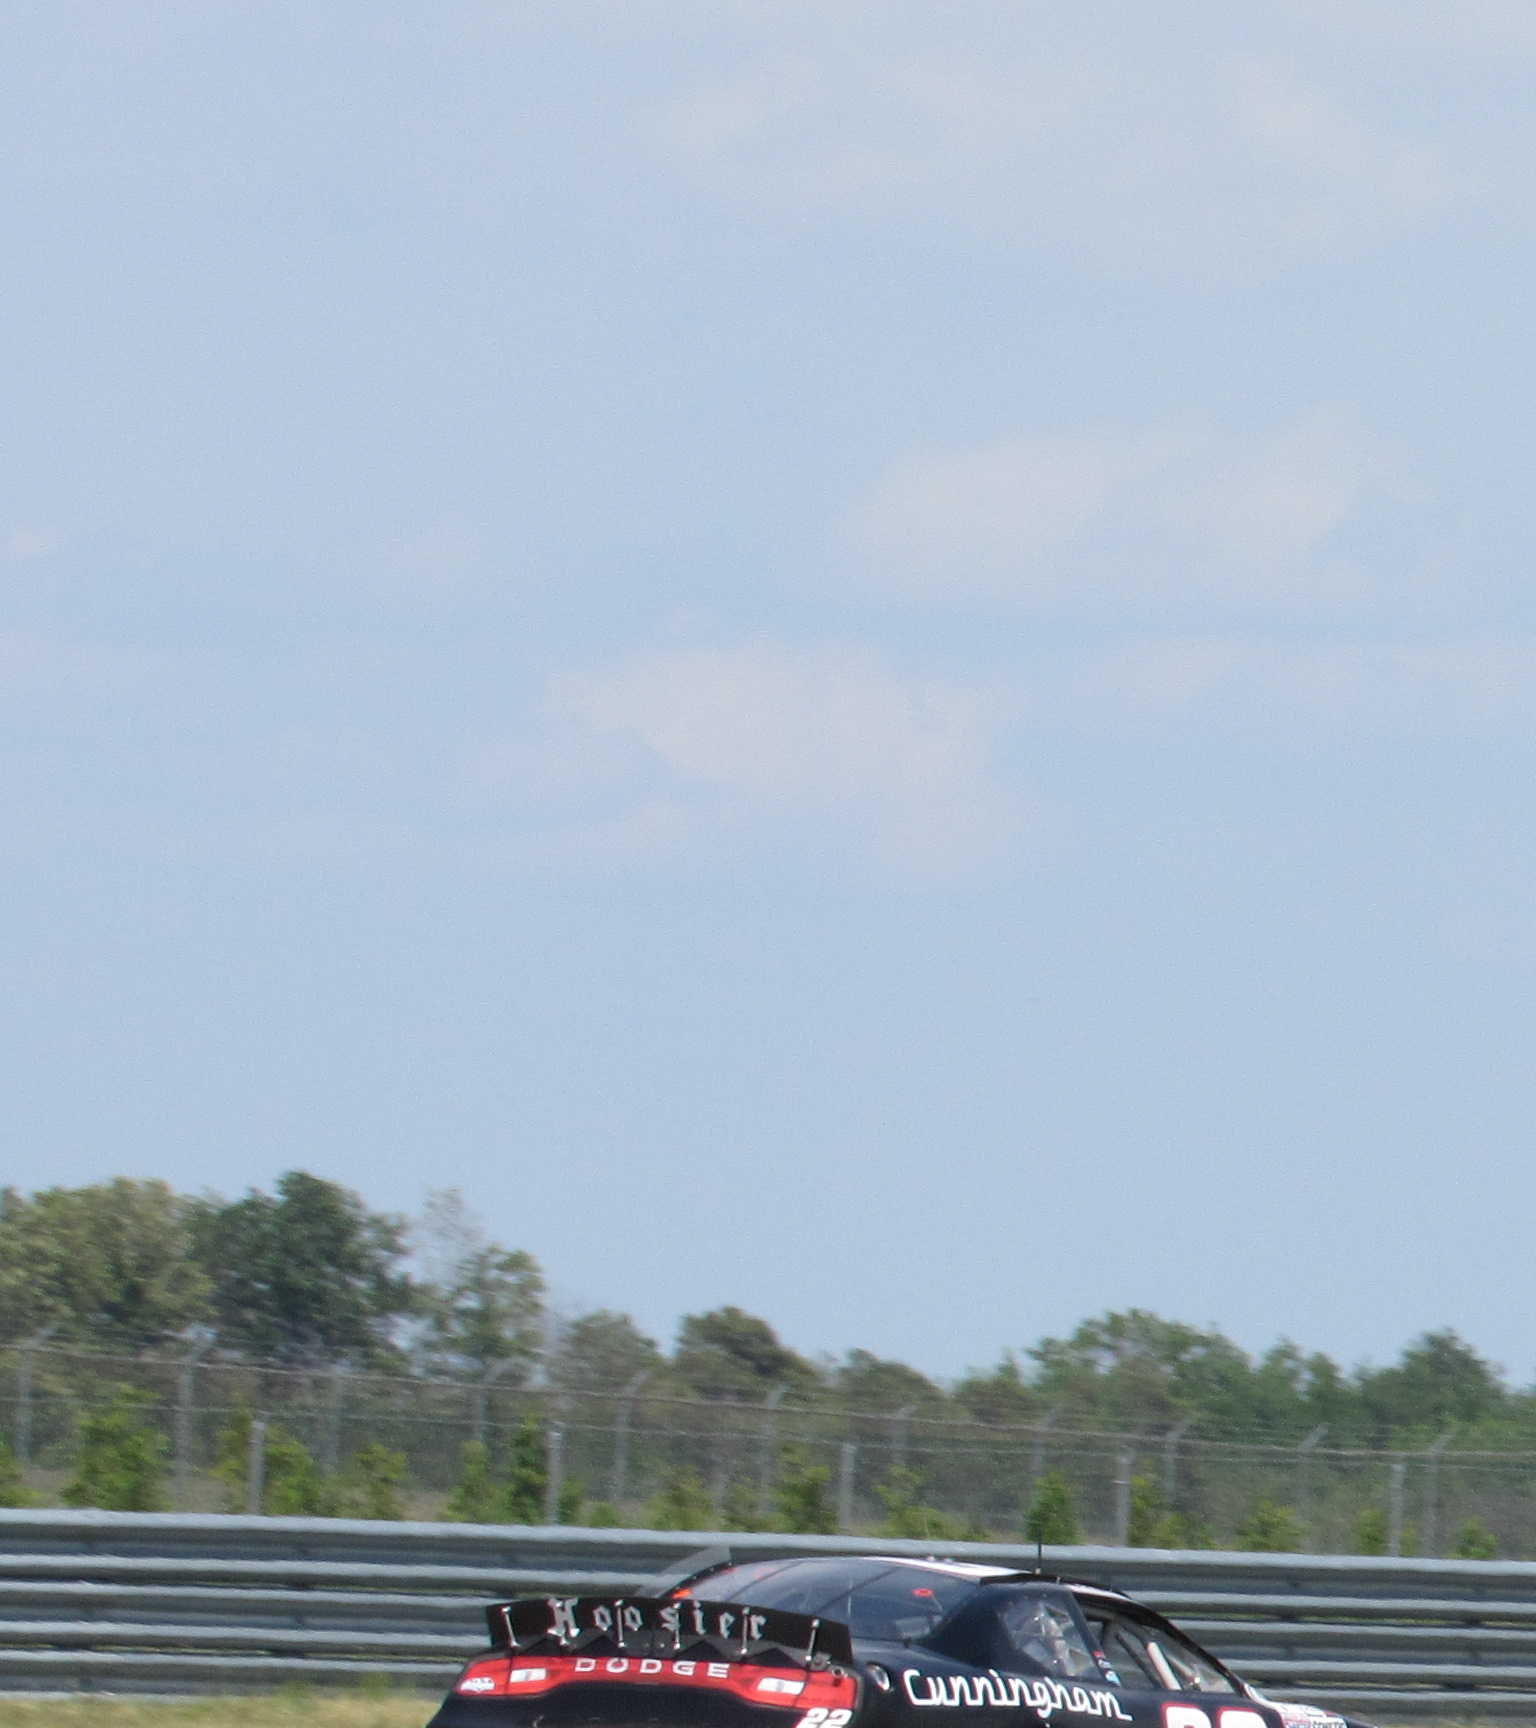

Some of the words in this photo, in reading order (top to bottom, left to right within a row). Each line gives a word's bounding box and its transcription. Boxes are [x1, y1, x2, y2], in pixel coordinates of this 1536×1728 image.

[546, 1595, 767, 1640] Hoosier
[574, 1657, 731, 1679] DODGE
[903, 1668, 1134, 1722] Cunningham
